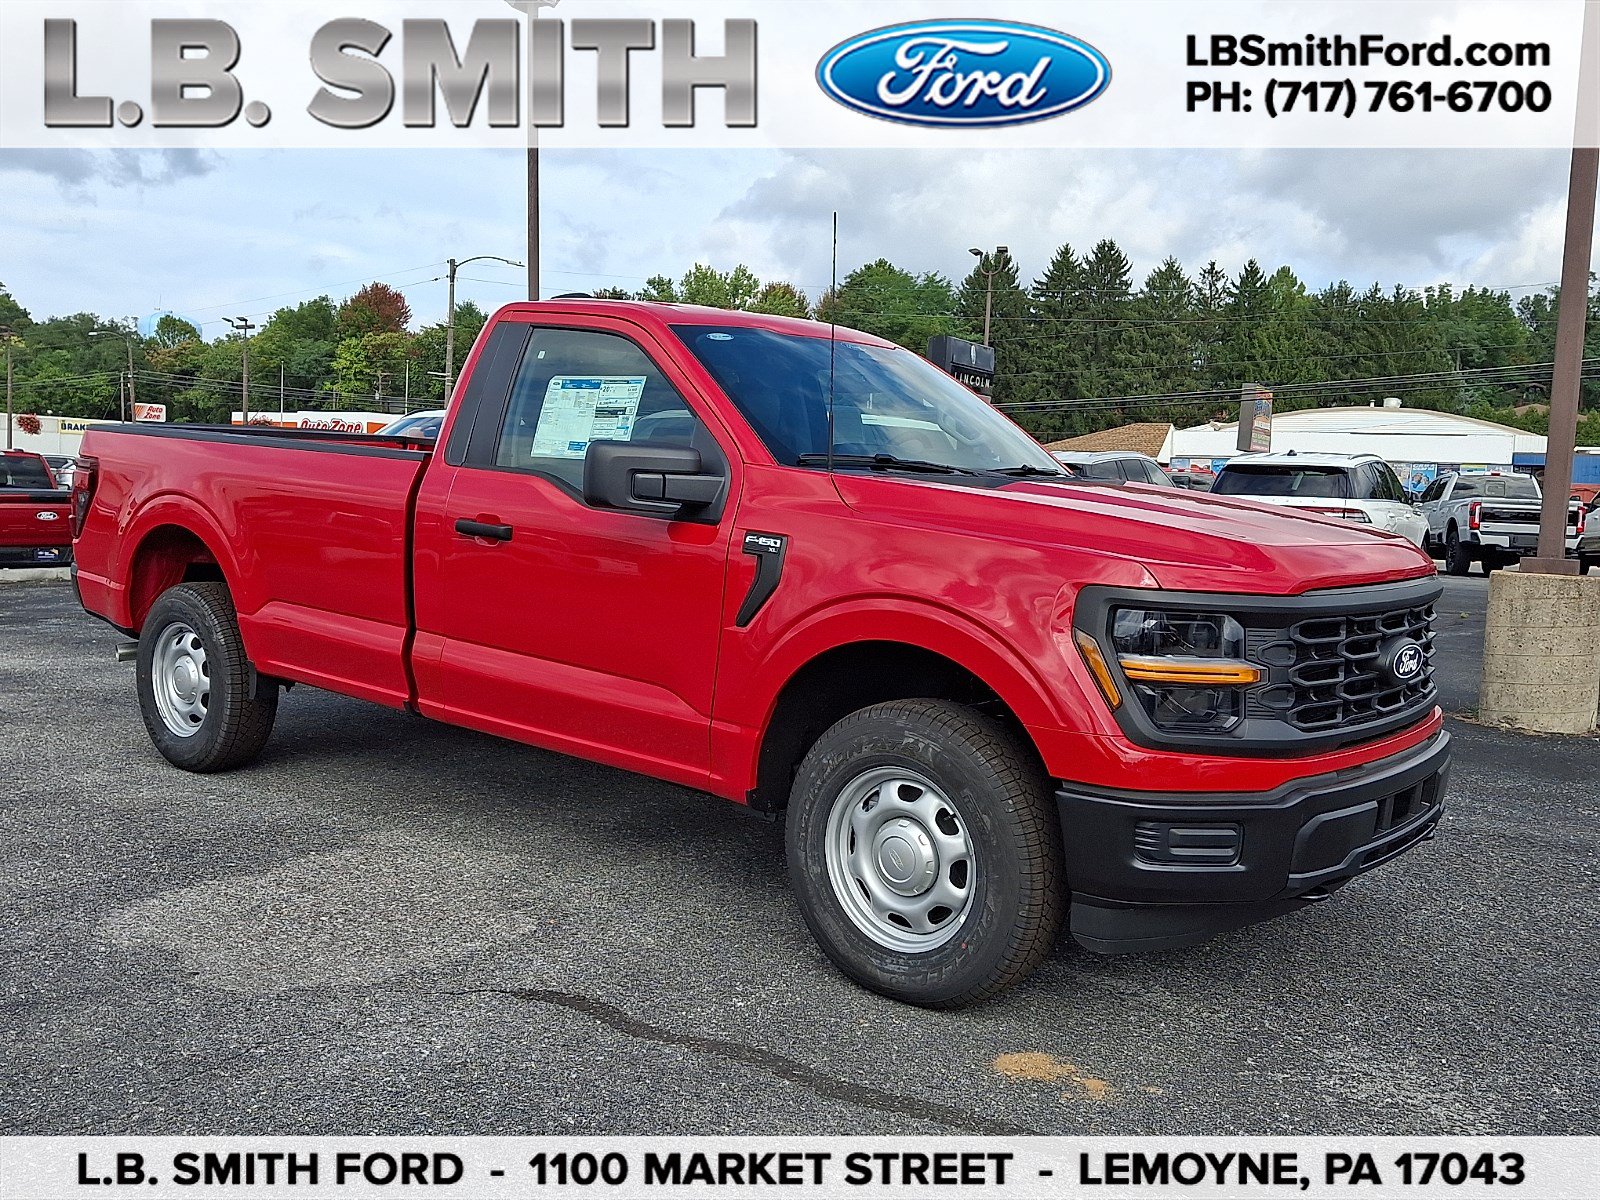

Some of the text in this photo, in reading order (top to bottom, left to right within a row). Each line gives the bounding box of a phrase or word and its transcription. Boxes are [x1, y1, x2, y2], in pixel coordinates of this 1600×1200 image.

[954, 371, 991, 388] LINCOLN
[147, 405, 163, 413] Auto
[61, 422, 88, 431] BRAK
[745, 535, 781, 547] F-150
[1400, 649, 1419, 674] Ford
